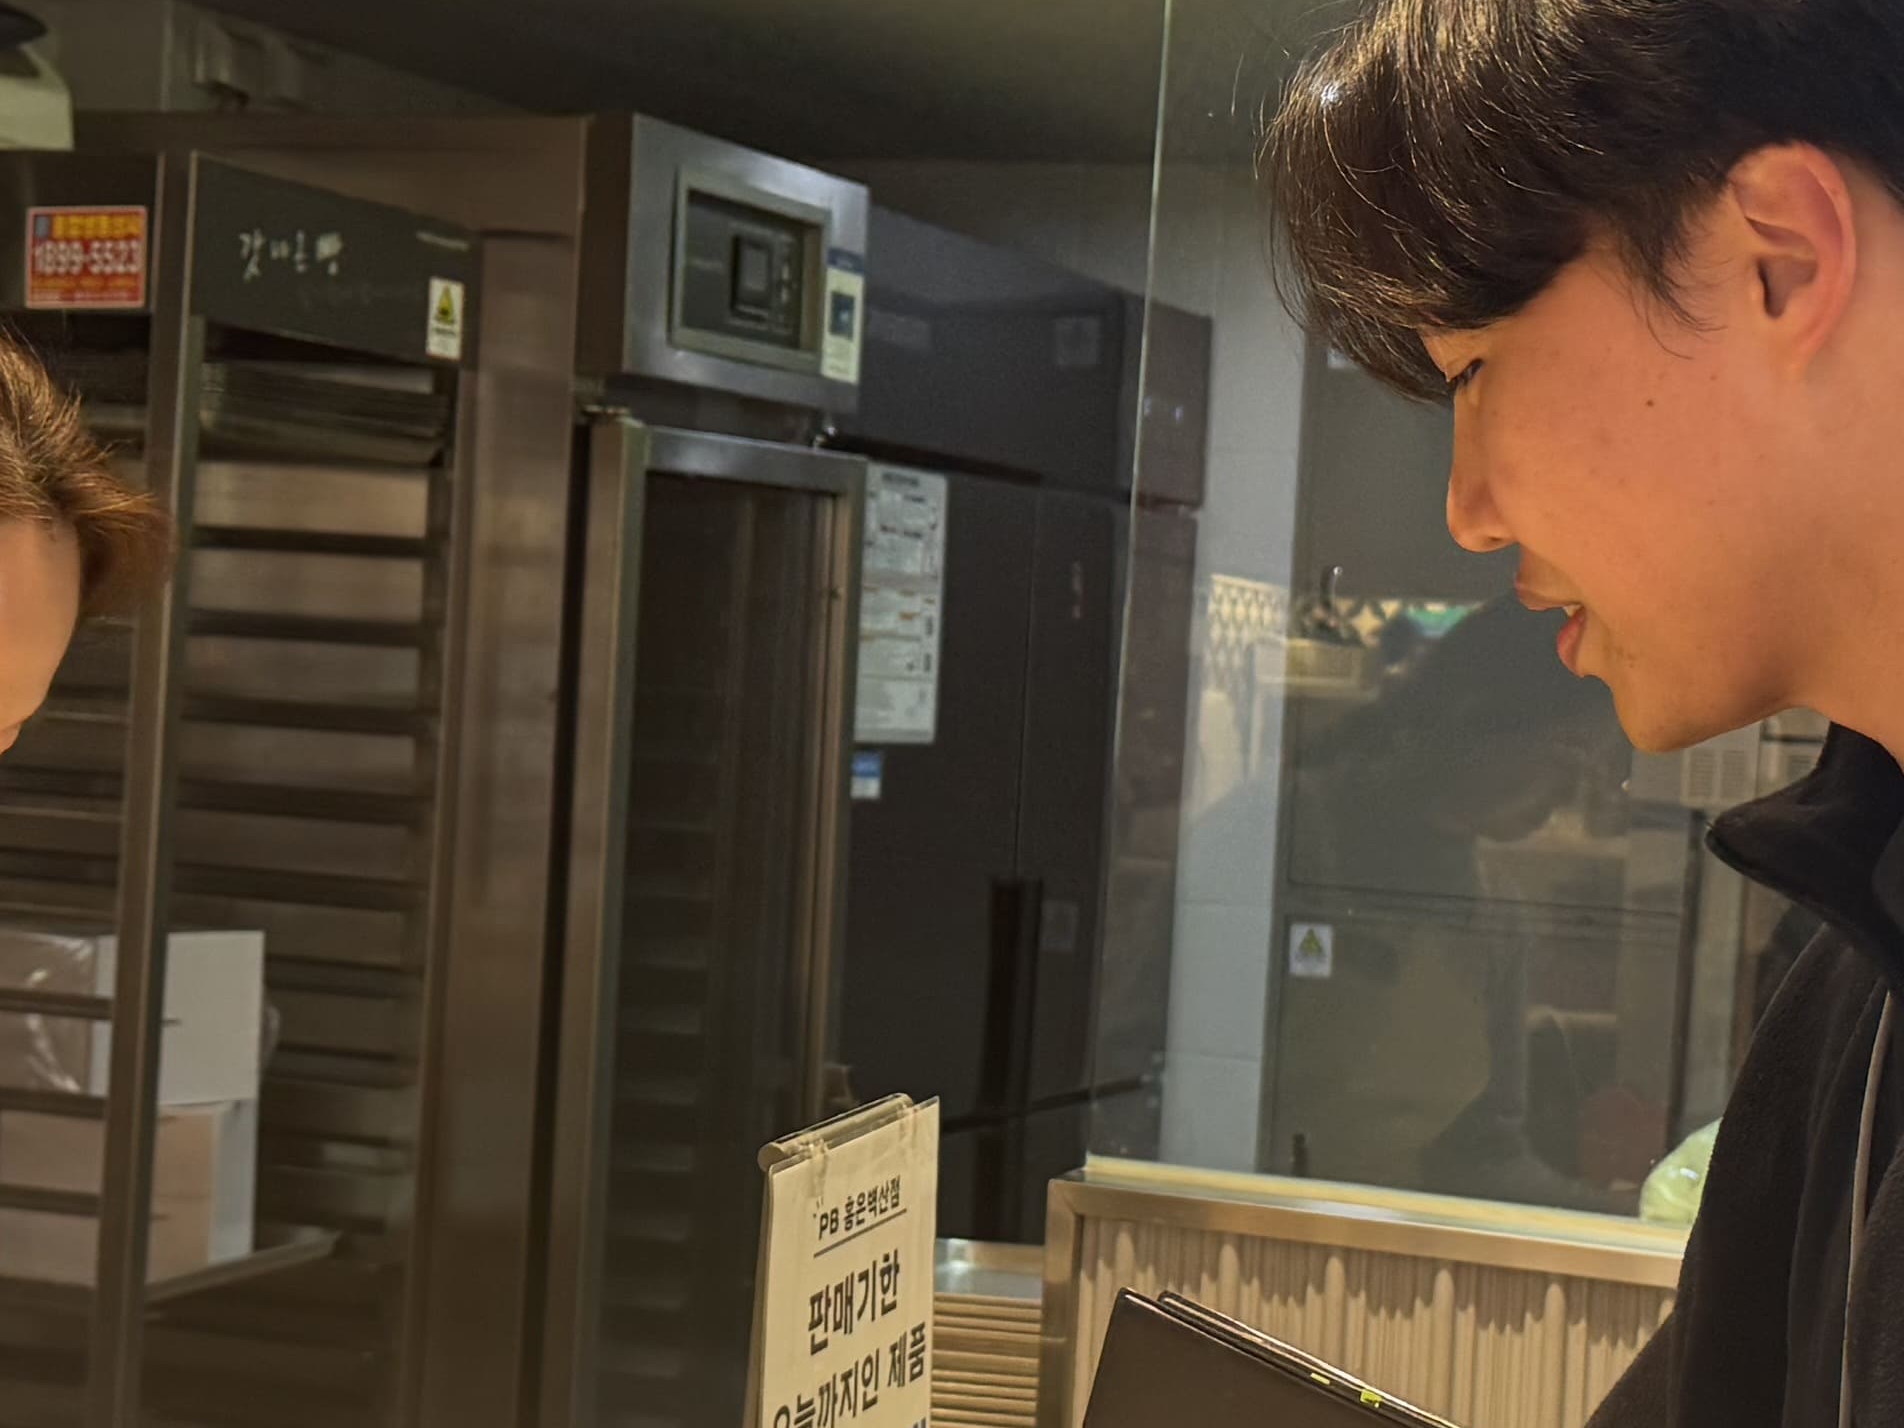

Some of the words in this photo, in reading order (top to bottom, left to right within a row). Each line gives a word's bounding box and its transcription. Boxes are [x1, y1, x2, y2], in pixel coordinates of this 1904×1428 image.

[818, 1206, 840, 1241] PB
[807, 1248, 900, 1356] 판매기한
[887, 1321, 927, 1389] 제품
